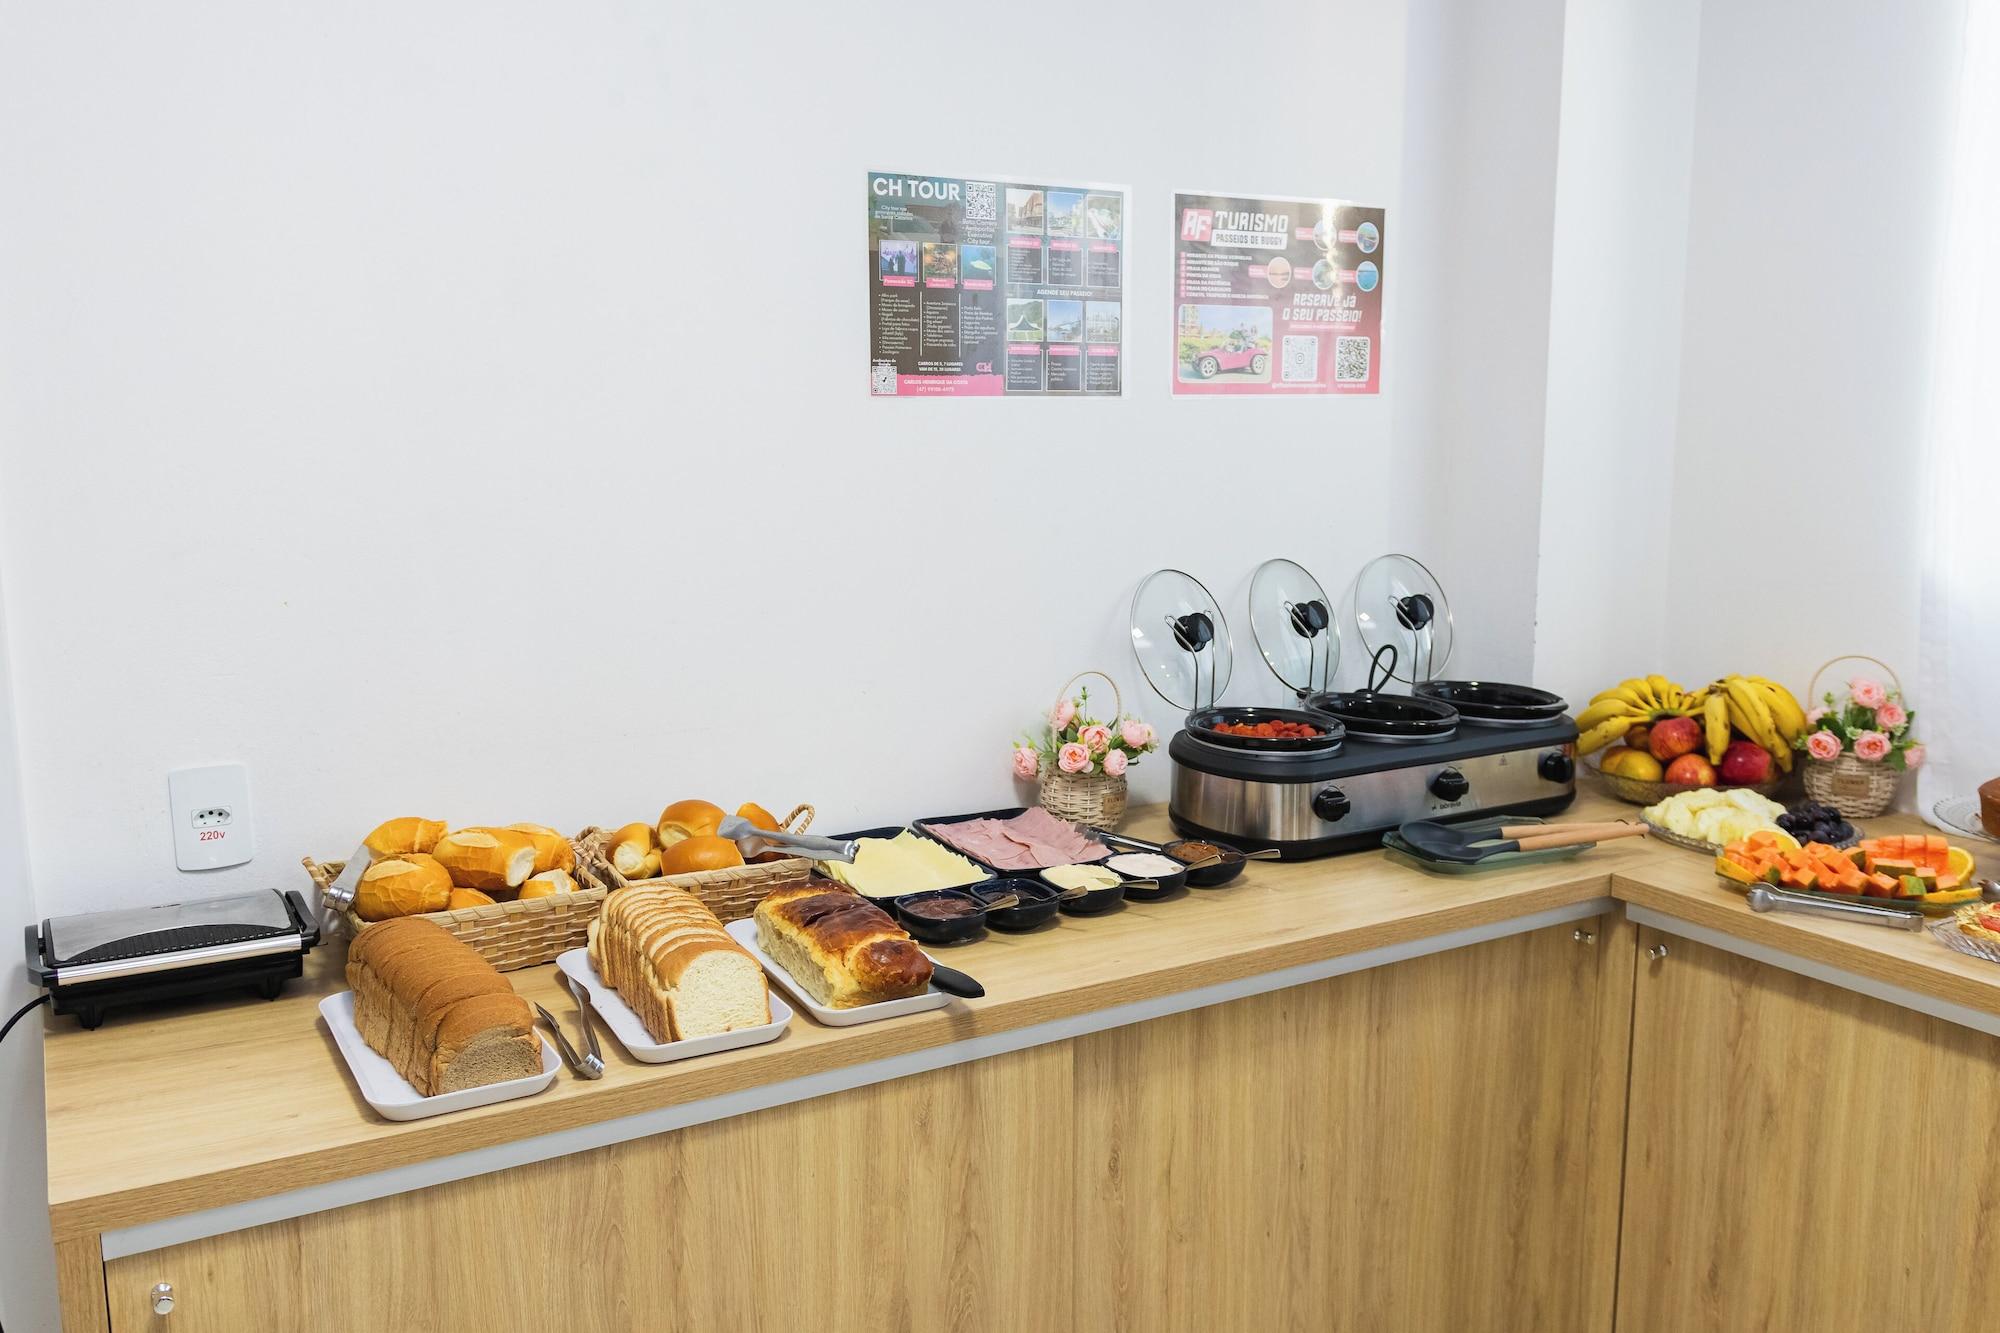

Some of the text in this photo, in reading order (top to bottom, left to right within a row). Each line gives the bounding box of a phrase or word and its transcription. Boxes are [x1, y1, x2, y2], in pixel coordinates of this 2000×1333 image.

[873, 177, 961, 201] CH TOUR
[1183, 210, 1289, 240] AF TURISMO
[1216, 233, 1248, 244] PASSEIOS
[1250, 235, 1259, 245] DE
[1282, 308, 1290, 321] O
[199, 830, 226, 842] 220v
